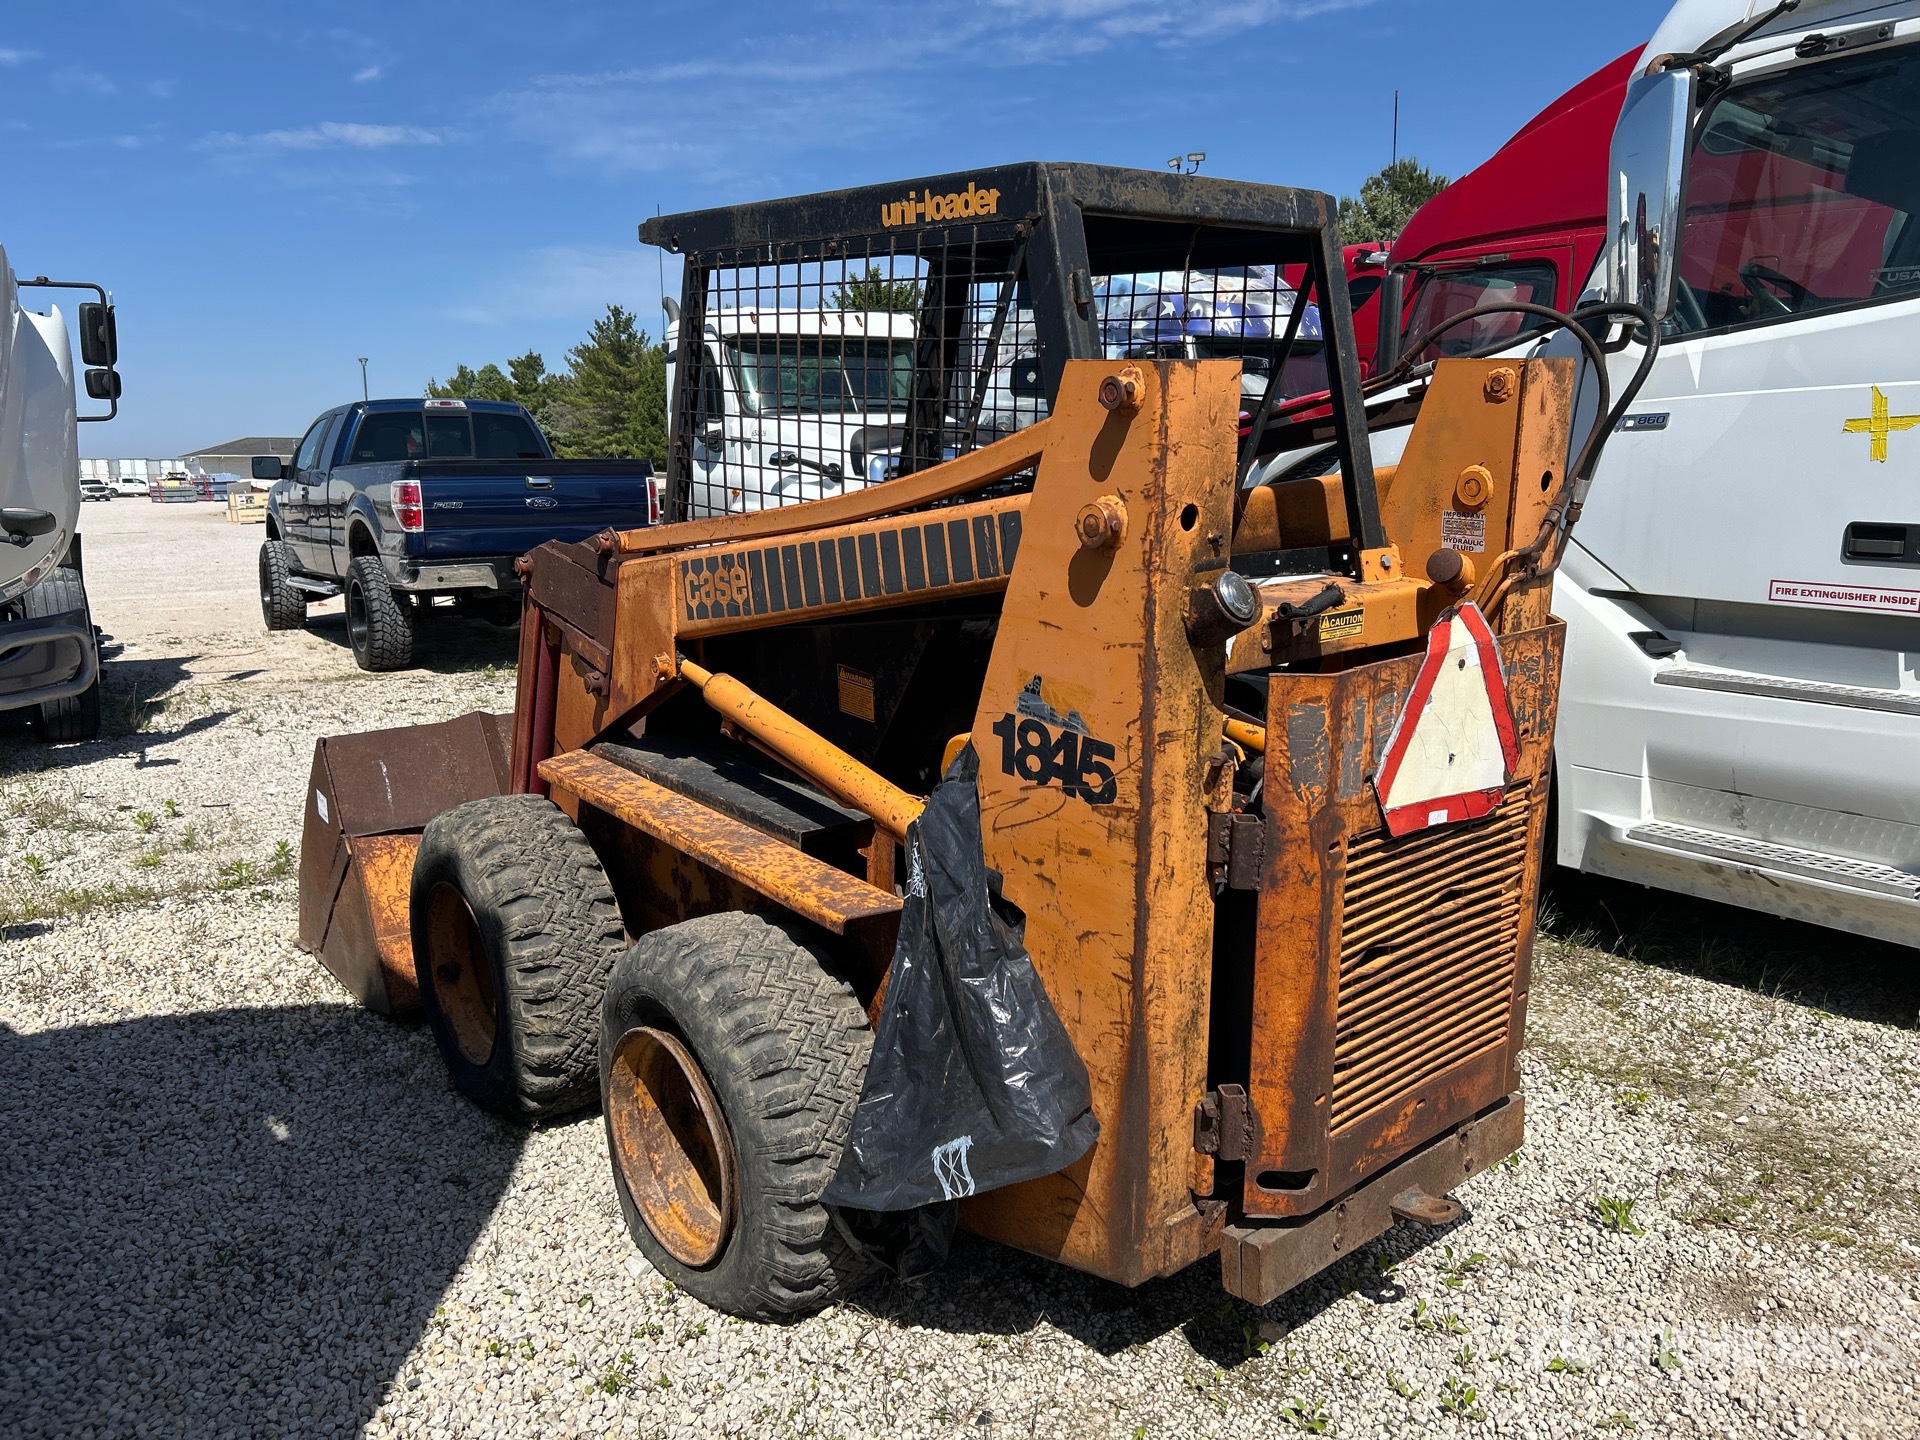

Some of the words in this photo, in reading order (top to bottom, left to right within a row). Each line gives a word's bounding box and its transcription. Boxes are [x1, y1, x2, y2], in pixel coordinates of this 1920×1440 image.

[881, 181, 1001, 227] uni-loader
[1637, 416, 1666, 425] 860
[1443, 511, 1485, 520] IMPORTANT
[1443, 536, 1484, 547] HYDRAULIC
[1452, 543, 1474, 552] FLUID
[1775, 587, 1798, 596] FIRE
[1800, 589, 1877, 602] EXTINGUISHER
[1879, 595, 1918, 606] INSIDE
[1330, 614, 1363, 627] CAUTION
[844, 671, 874, 687] WARNING
[992, 712, 1117, 805] 1845
